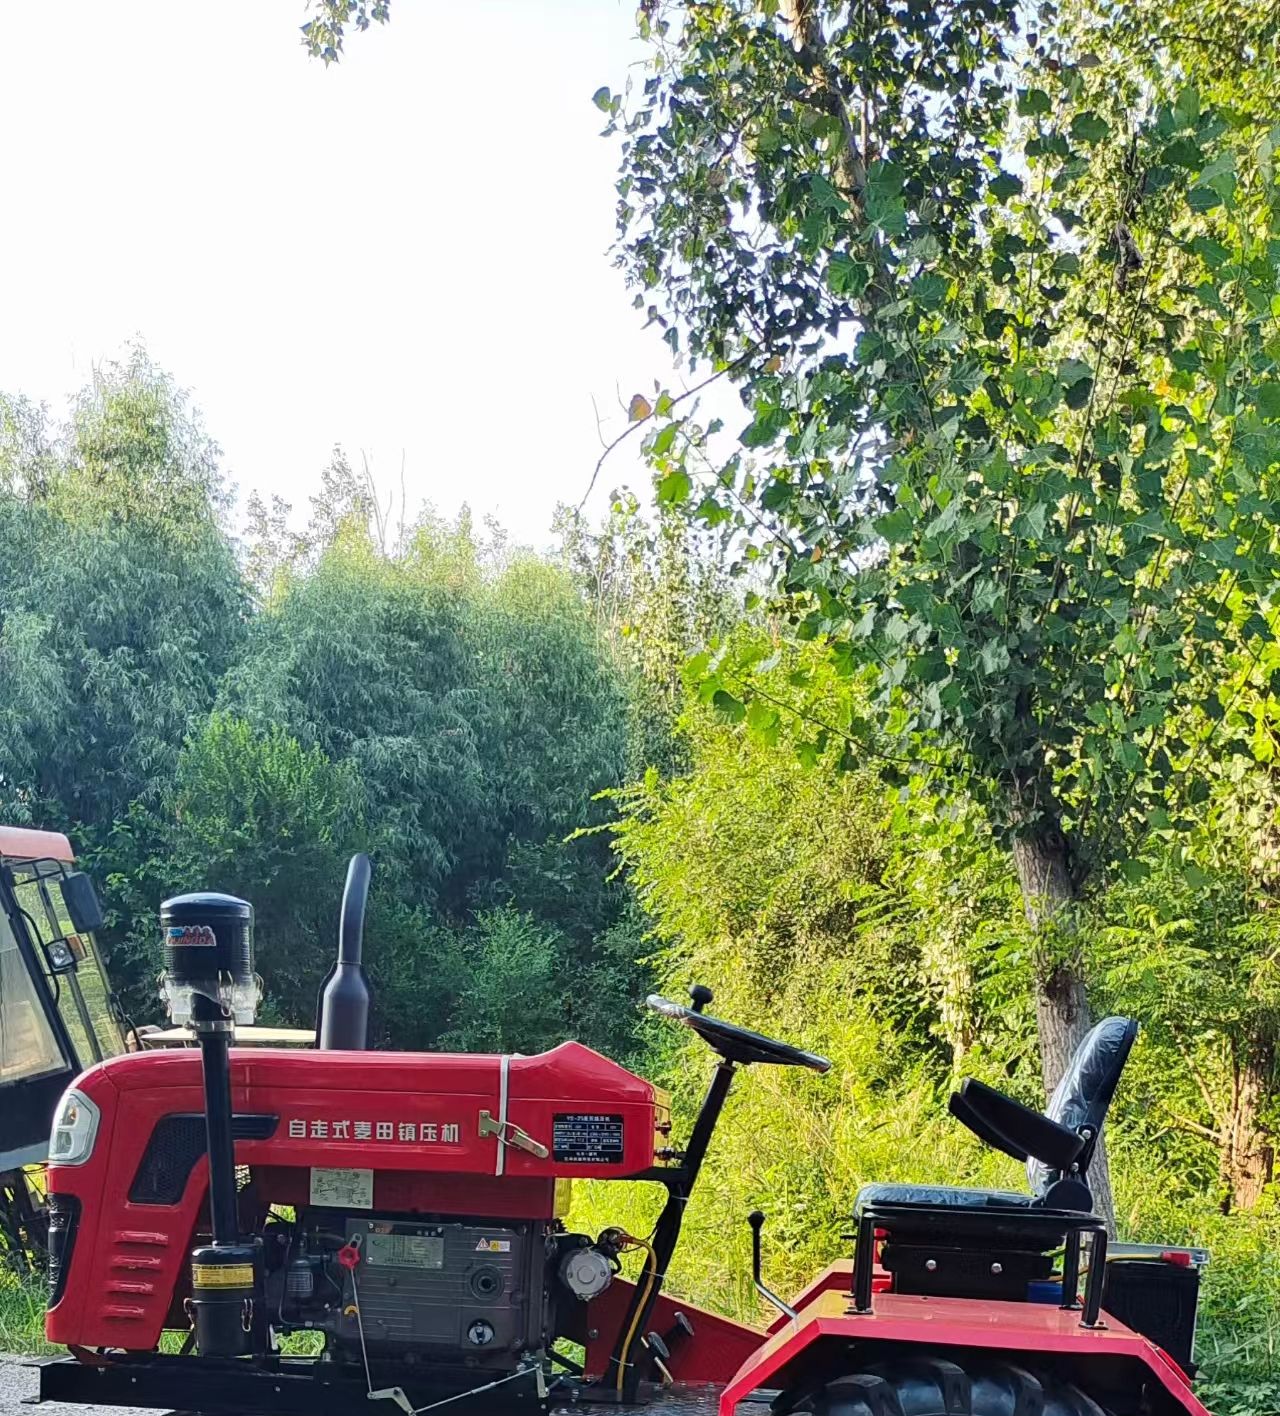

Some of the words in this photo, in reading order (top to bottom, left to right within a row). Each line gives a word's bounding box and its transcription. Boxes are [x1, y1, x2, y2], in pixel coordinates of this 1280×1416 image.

[288, 1119, 459, 1143] 自走式麦田镇压机
